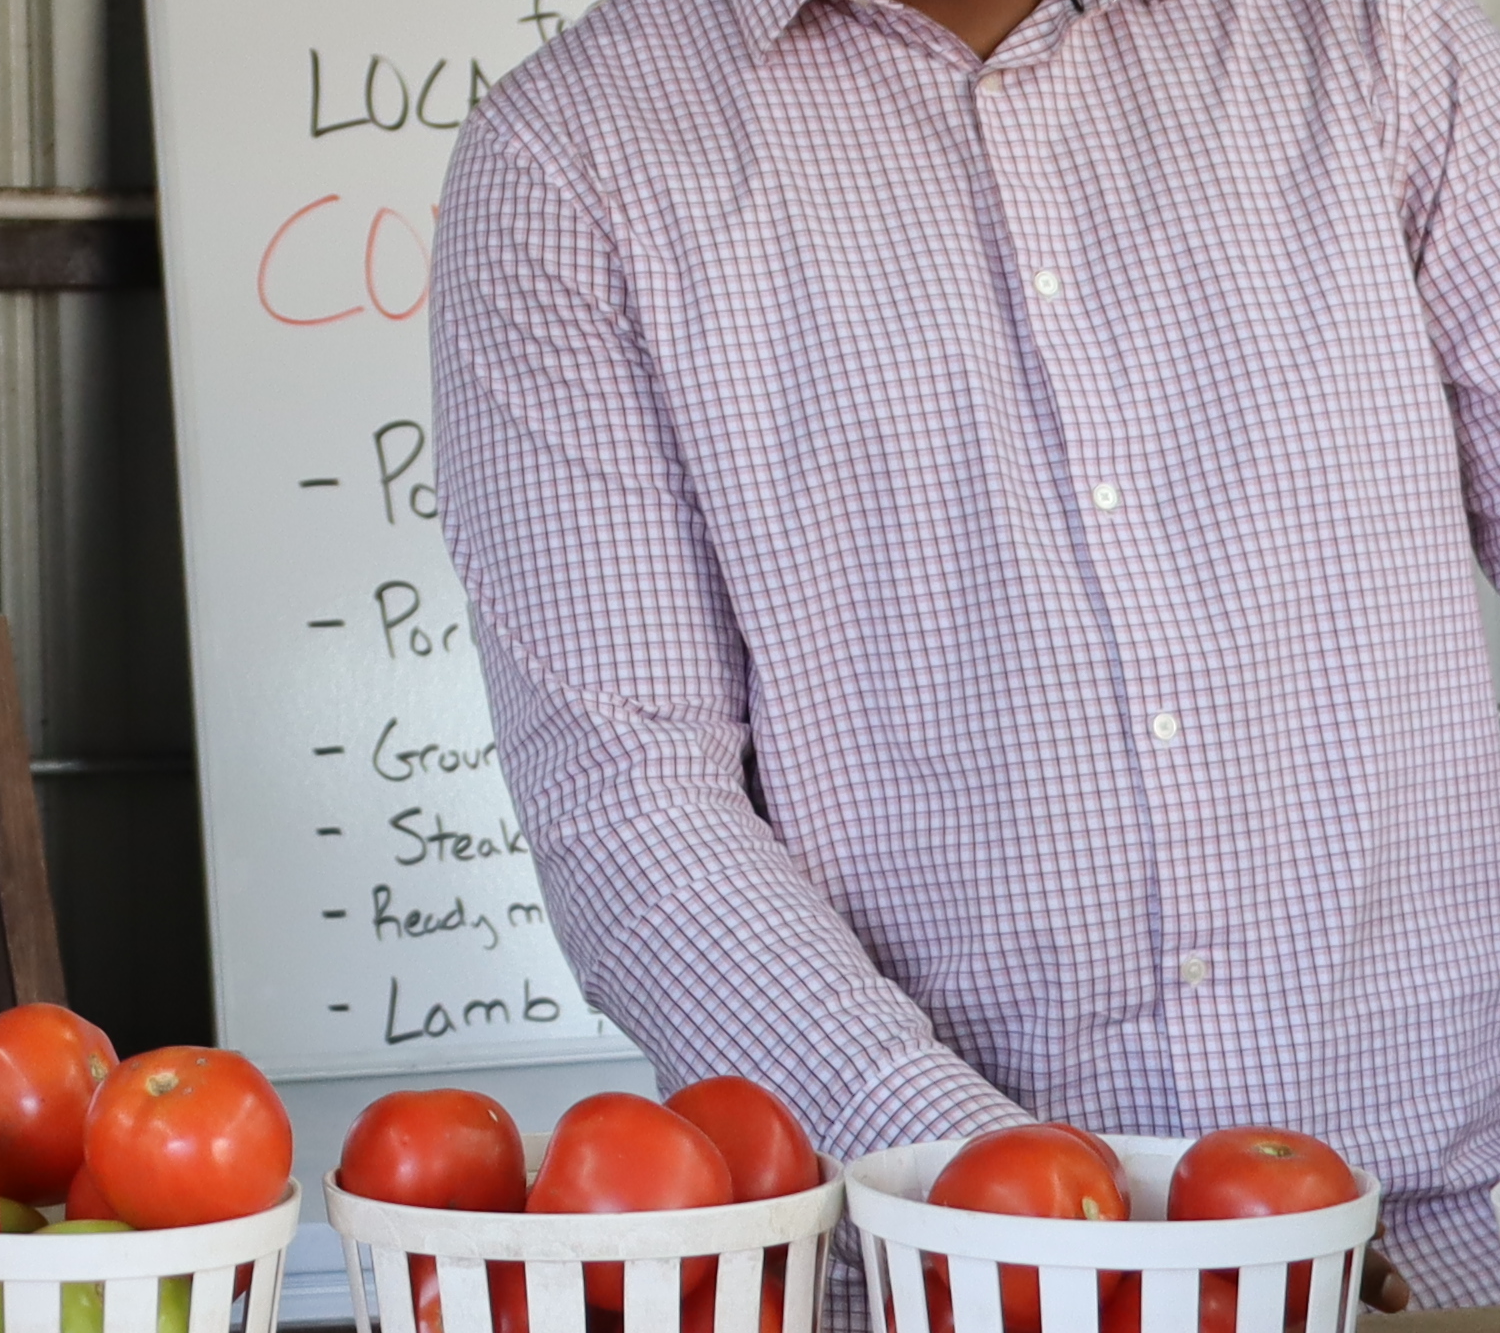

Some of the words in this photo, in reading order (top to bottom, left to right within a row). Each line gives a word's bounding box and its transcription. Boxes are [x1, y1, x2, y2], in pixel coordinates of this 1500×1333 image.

[308, 46, 493, 139] LOCA
[255, 192, 441, 327] CO
[373, 418, 439, 526] Po
[374, 579, 460, 661] Por
[371, 716, 497, 783] Grou
[371, 883, 499, 952] Ready
[384, 976, 560, 1045] Lamb
